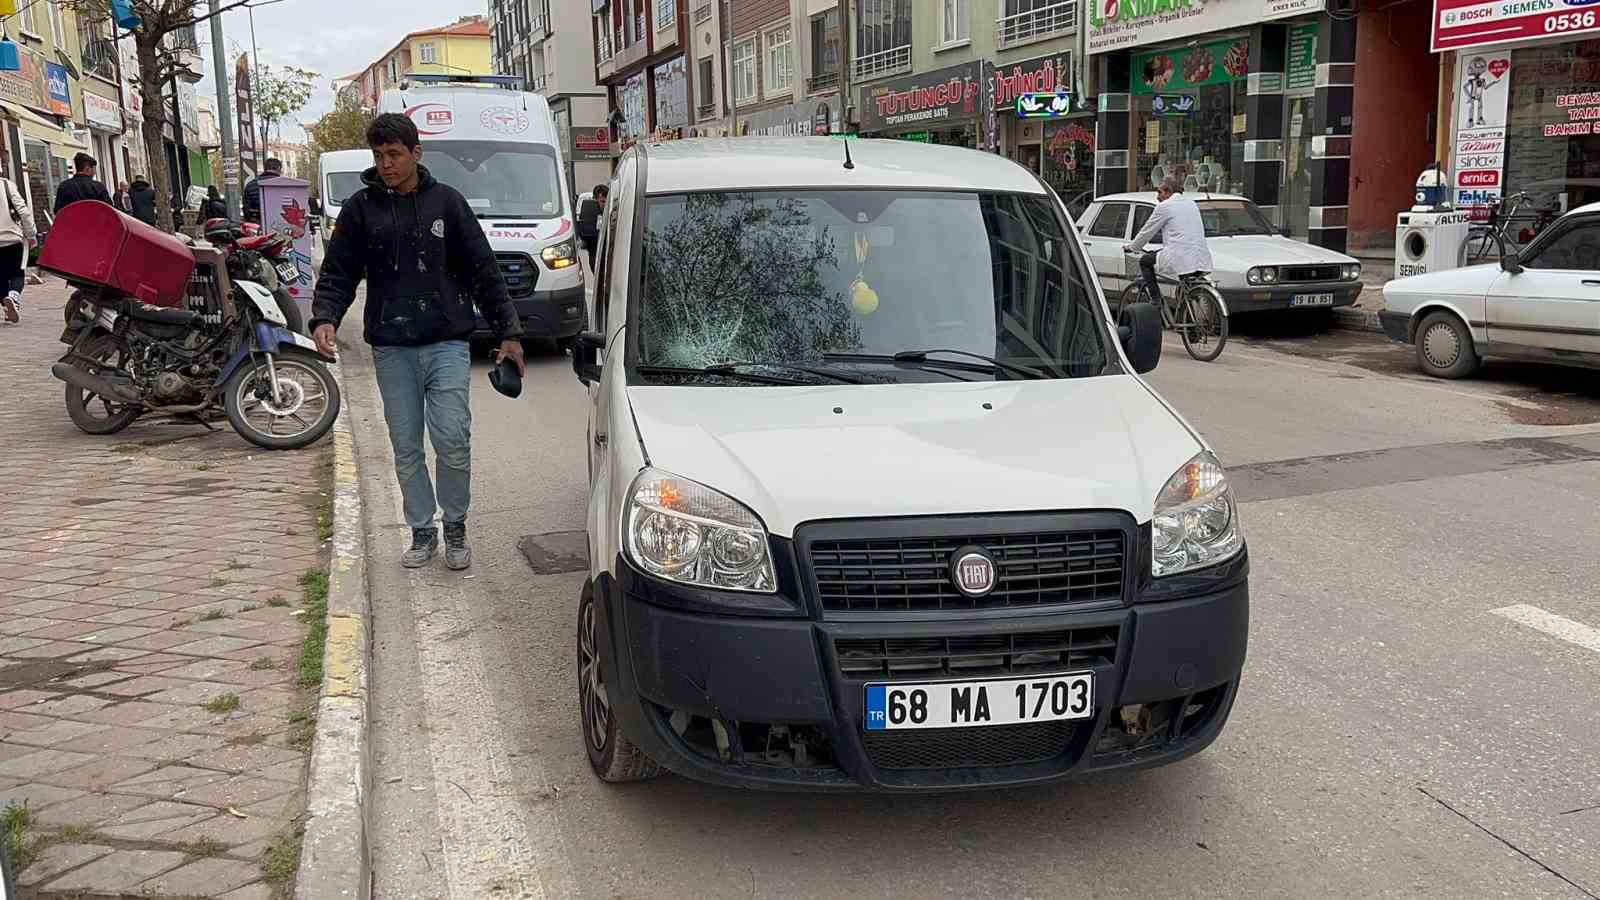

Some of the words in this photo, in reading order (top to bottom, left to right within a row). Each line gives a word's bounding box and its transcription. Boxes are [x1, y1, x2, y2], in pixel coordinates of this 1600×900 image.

[1159, 12, 1180, 23] Organik
[1459, 8, 1493, 21] BOSCH
[1502, 0, 1554, 15] SIEMENS
[1544, 11, 1596, 32] 0536
[995, 59, 1055, 104] ÜTÜNCÜ
[876, 77, 962, 116] TÜTÜNCÜ
[1556, 91, 1600, 107] BEYAZ
[886, 115, 904, 125] TOPTAN
[904, 110, 933, 122] PERAKENDE
[933, 107, 949, 119] SATIŞ
[1544, 122, 1590, 137] BAKIM
[1460, 141, 1502, 152] arzum
[1461, 172, 1496, 184] arnica
[1441, 214, 1470, 225] ALTUS
[963, 563, 987, 585] FIAT
[869, 710, 884, 721] TR
[888, 689, 928, 725] 68
[951, 686, 991, 723] MA
[1015, 679, 1089, 719] 1703
